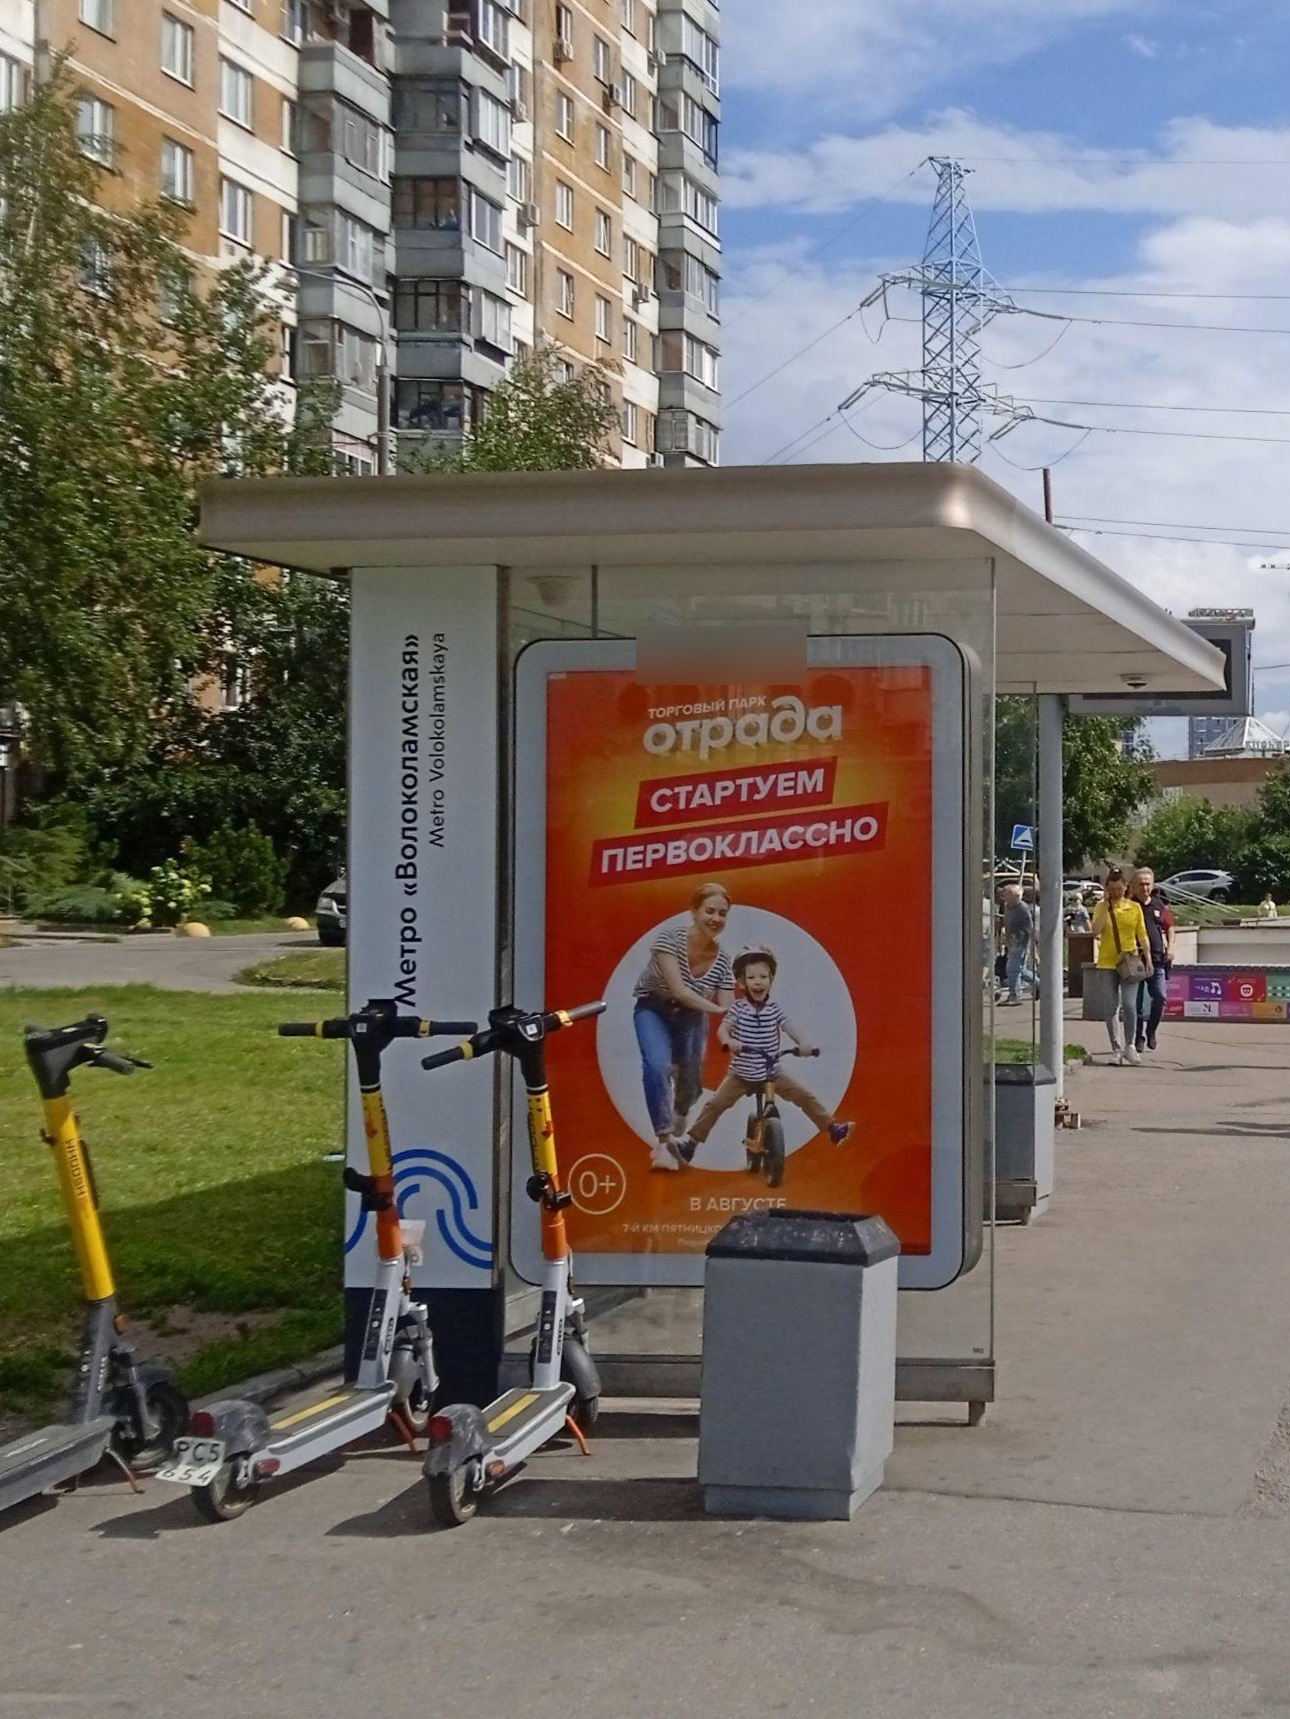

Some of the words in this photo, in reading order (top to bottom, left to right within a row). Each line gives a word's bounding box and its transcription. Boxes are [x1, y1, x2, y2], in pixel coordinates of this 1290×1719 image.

[429, 633, 448, 782] Volokolamskaya
[643, 695, 843, 760] отрада
[648, 698, 725, 719] ТОРГОВЫЙ
[728, 696, 767, 710] ПАРК
[395, 635, 419, 896] «Волоколамская»
[650, 768, 825, 813] СТАРТУЕМ
[429, 789, 445, 848] Metro
[601, 816, 879, 874] ПЕРВОКЛАССНО
[394, 907, 422, 1007] Метро
[579, 1171, 617, 1198] 0+
[690, 1197, 701, 1211] В
[706, 1197, 787, 1211] АВГУСТЕ
[162, 1467, 212, 1483] 654
